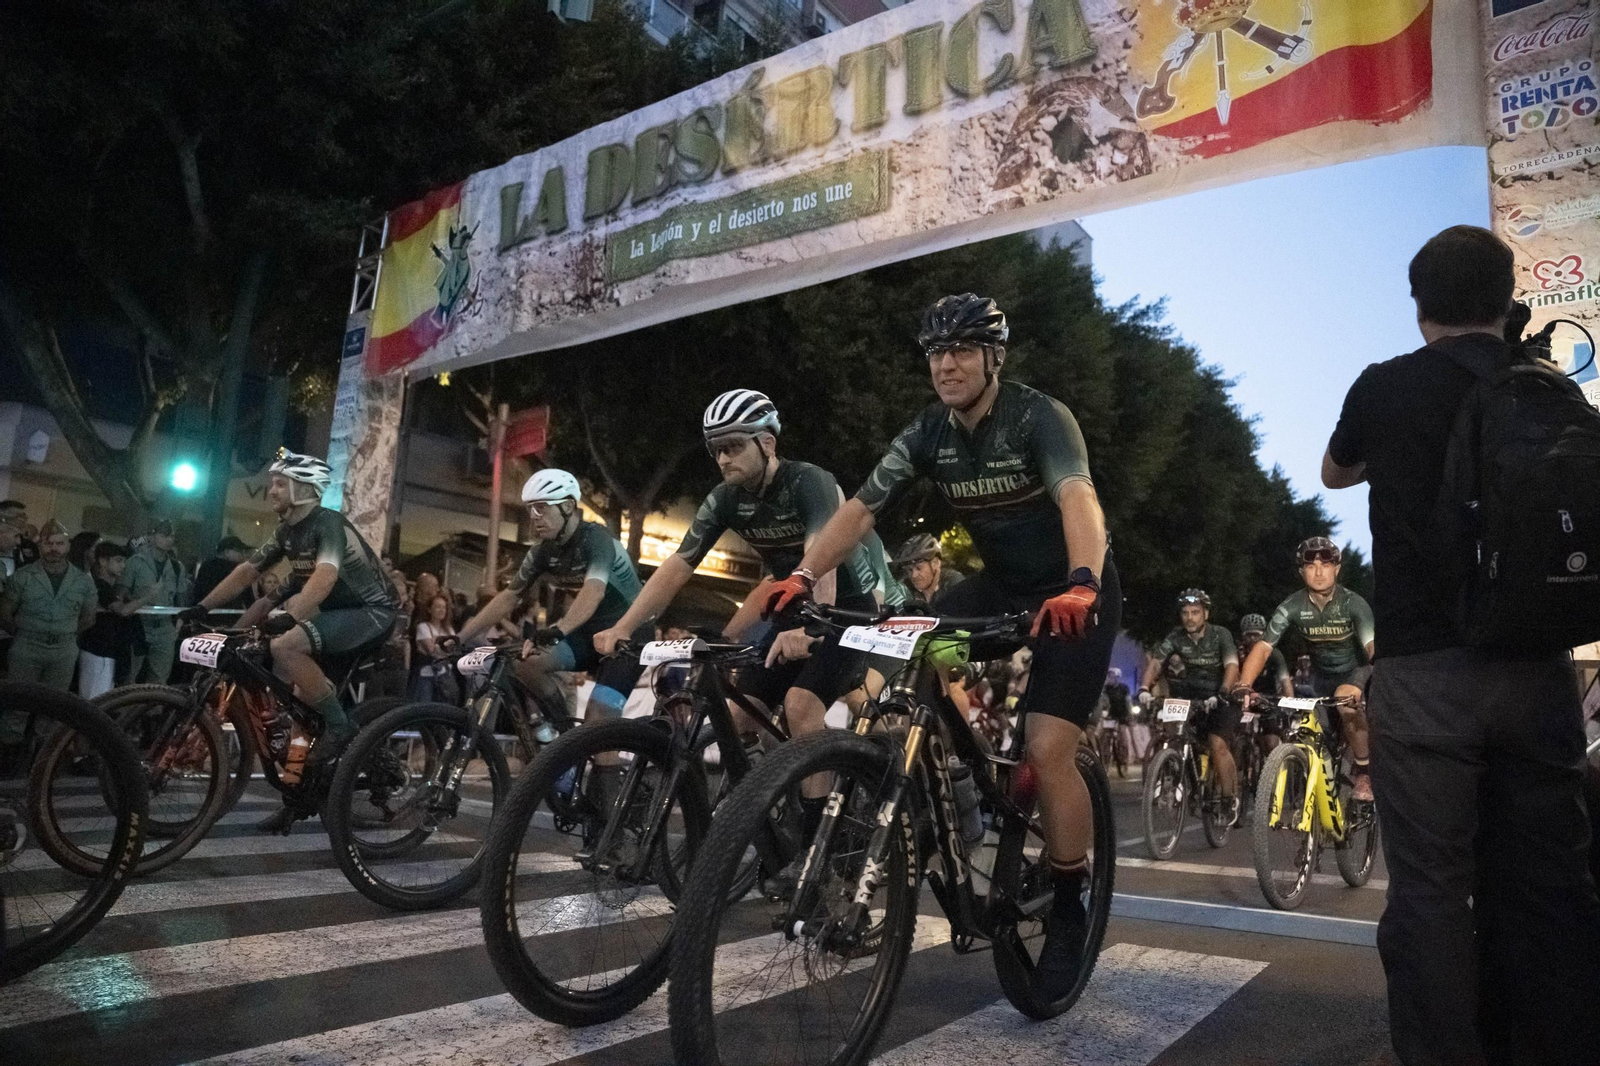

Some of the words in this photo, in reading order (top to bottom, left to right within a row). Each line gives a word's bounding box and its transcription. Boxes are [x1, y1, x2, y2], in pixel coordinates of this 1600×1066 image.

[1493, 11, 1595, 62] Coca-Cola
[1501, 61, 1592, 94] GRUPO
[1501, 75, 1597, 113] RENTA
[499, 166, 568, 253] LA
[584, 0, 1097, 221] DESÉRTICA
[1502, 96, 1598, 135] TODO
[629, 239, 644, 259] La
[650, 221, 683, 253] Legión
[691, 222, 702, 241] y
[708, 213, 721, 235] el
[728, 201, 784, 230] desierto
[793, 193, 817, 213] nos
[825, 181, 853, 203] une
[996, 457, 1022, 468] EDICIÓN
[951, 472, 1030, 499] DESÉRTICA
[188, 639, 219, 656] 5224
[113, 811, 139, 880] MAXXIS
